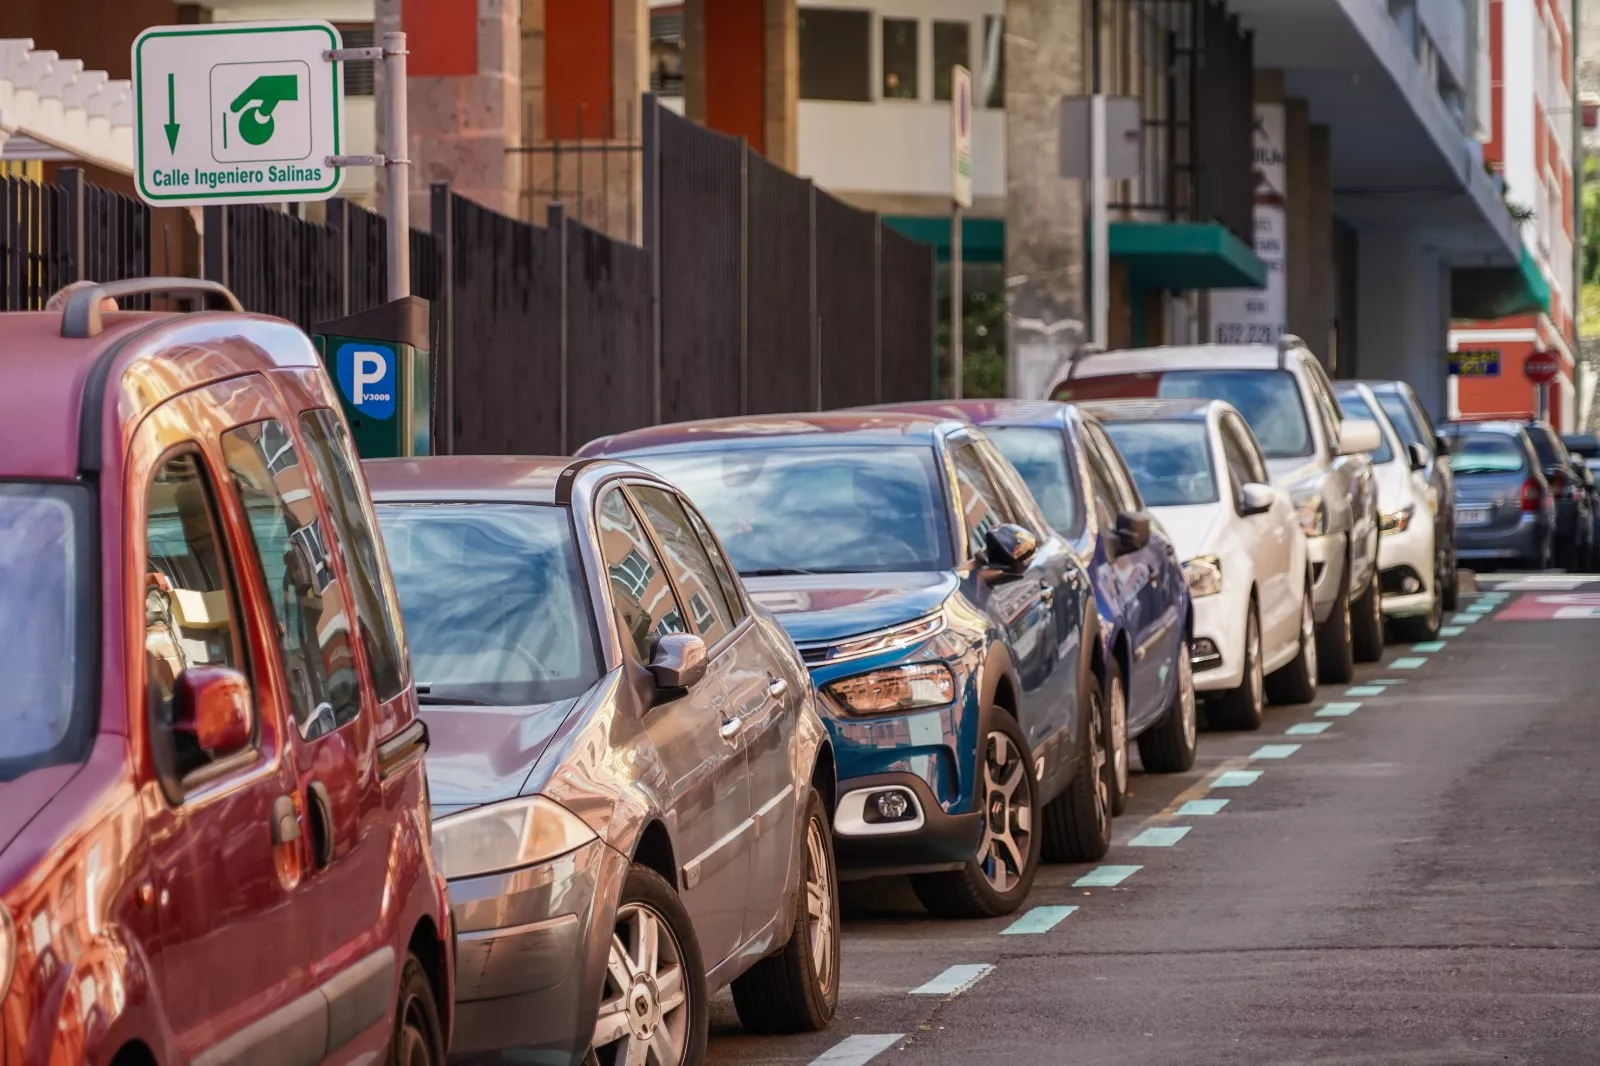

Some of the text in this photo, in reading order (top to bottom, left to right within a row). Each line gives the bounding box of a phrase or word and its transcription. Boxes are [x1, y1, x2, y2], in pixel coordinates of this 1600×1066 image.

[153, 165, 322, 189] Calle Ingeniero Salinas
[354, 351, 387, 405] P
[363, 393, 391, 402] V3009
